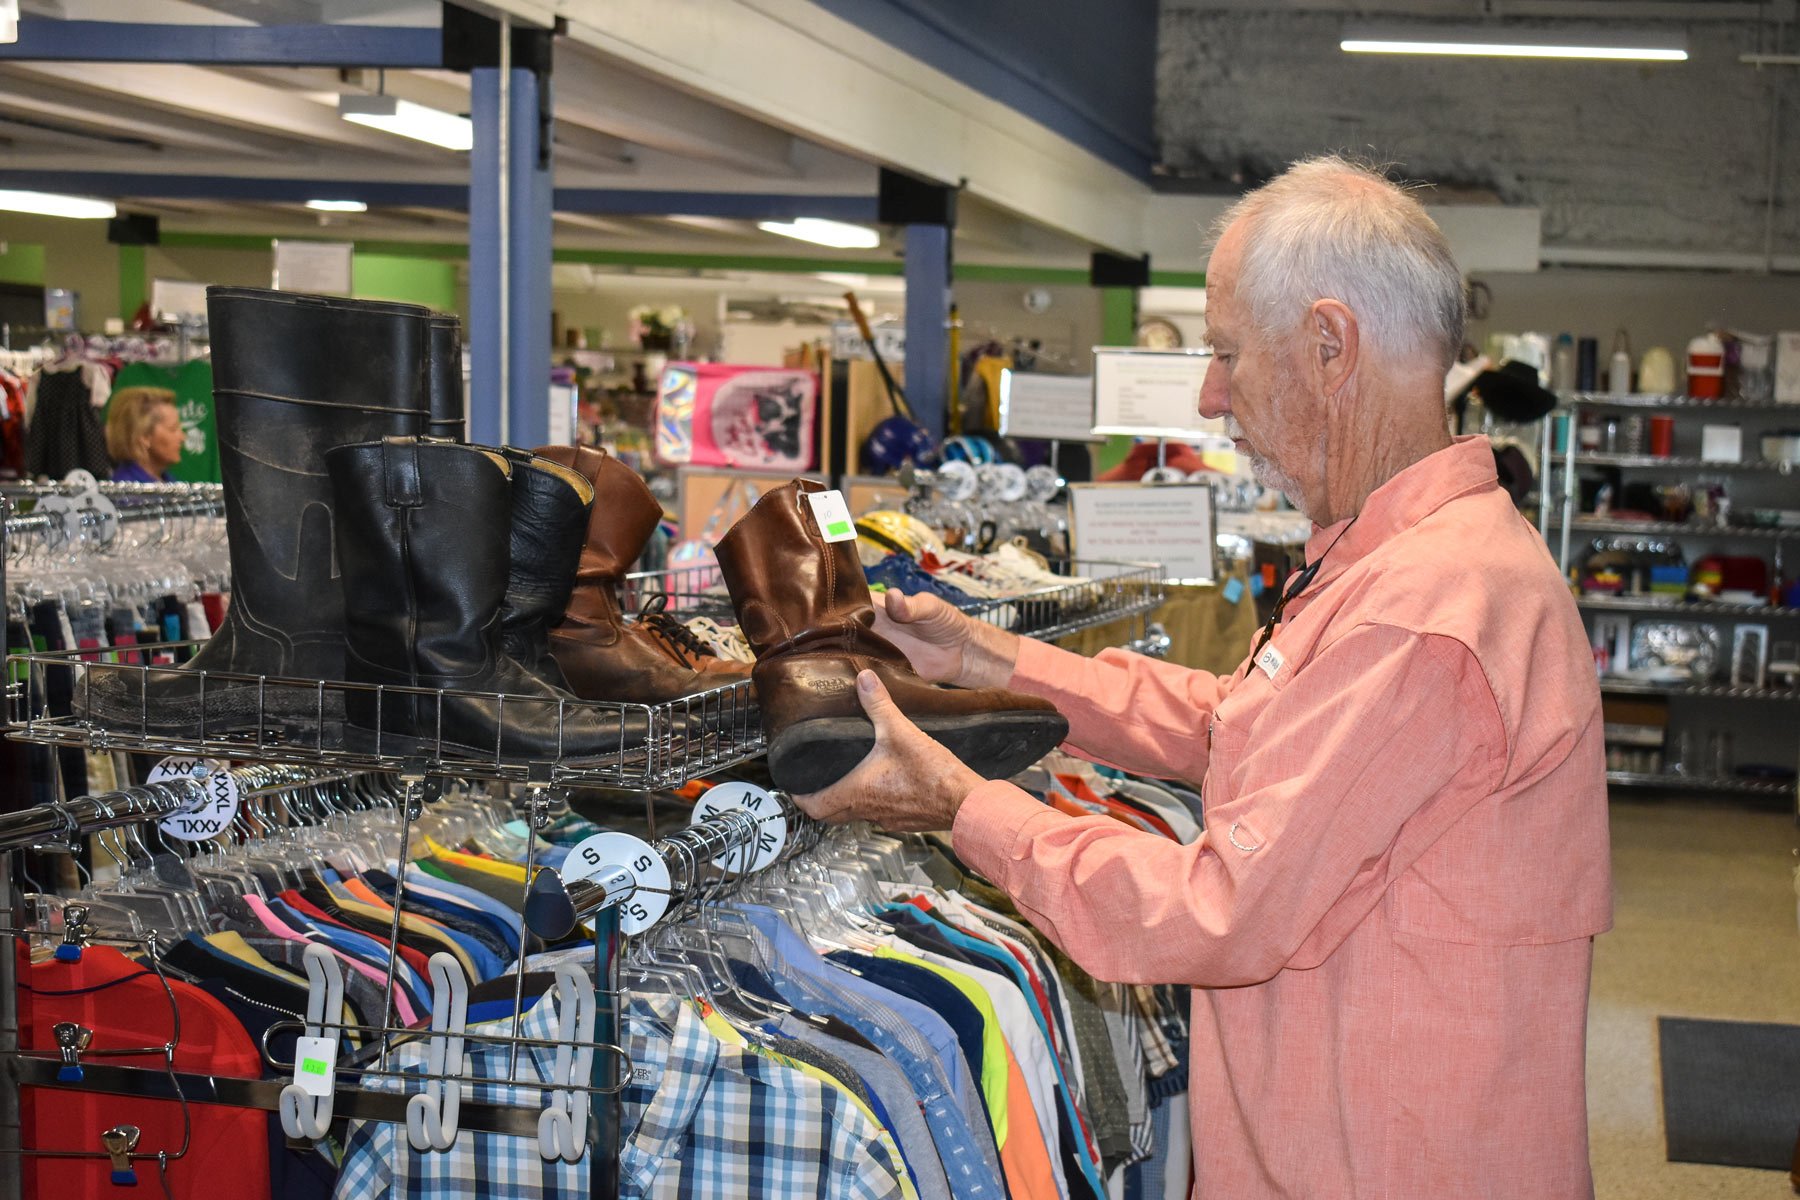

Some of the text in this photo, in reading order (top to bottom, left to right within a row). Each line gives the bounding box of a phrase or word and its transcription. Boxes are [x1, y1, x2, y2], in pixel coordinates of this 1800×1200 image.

[160, 761, 195, 777] XXX
[214, 772, 231, 814] XXXL
[741, 791, 763, 811] M
[177, 819, 222, 834] XXXL
[759, 832, 778, 853] M
[581, 847, 601, 866] S
[633, 855, 653, 873] S
[629, 903, 648, 922] S
